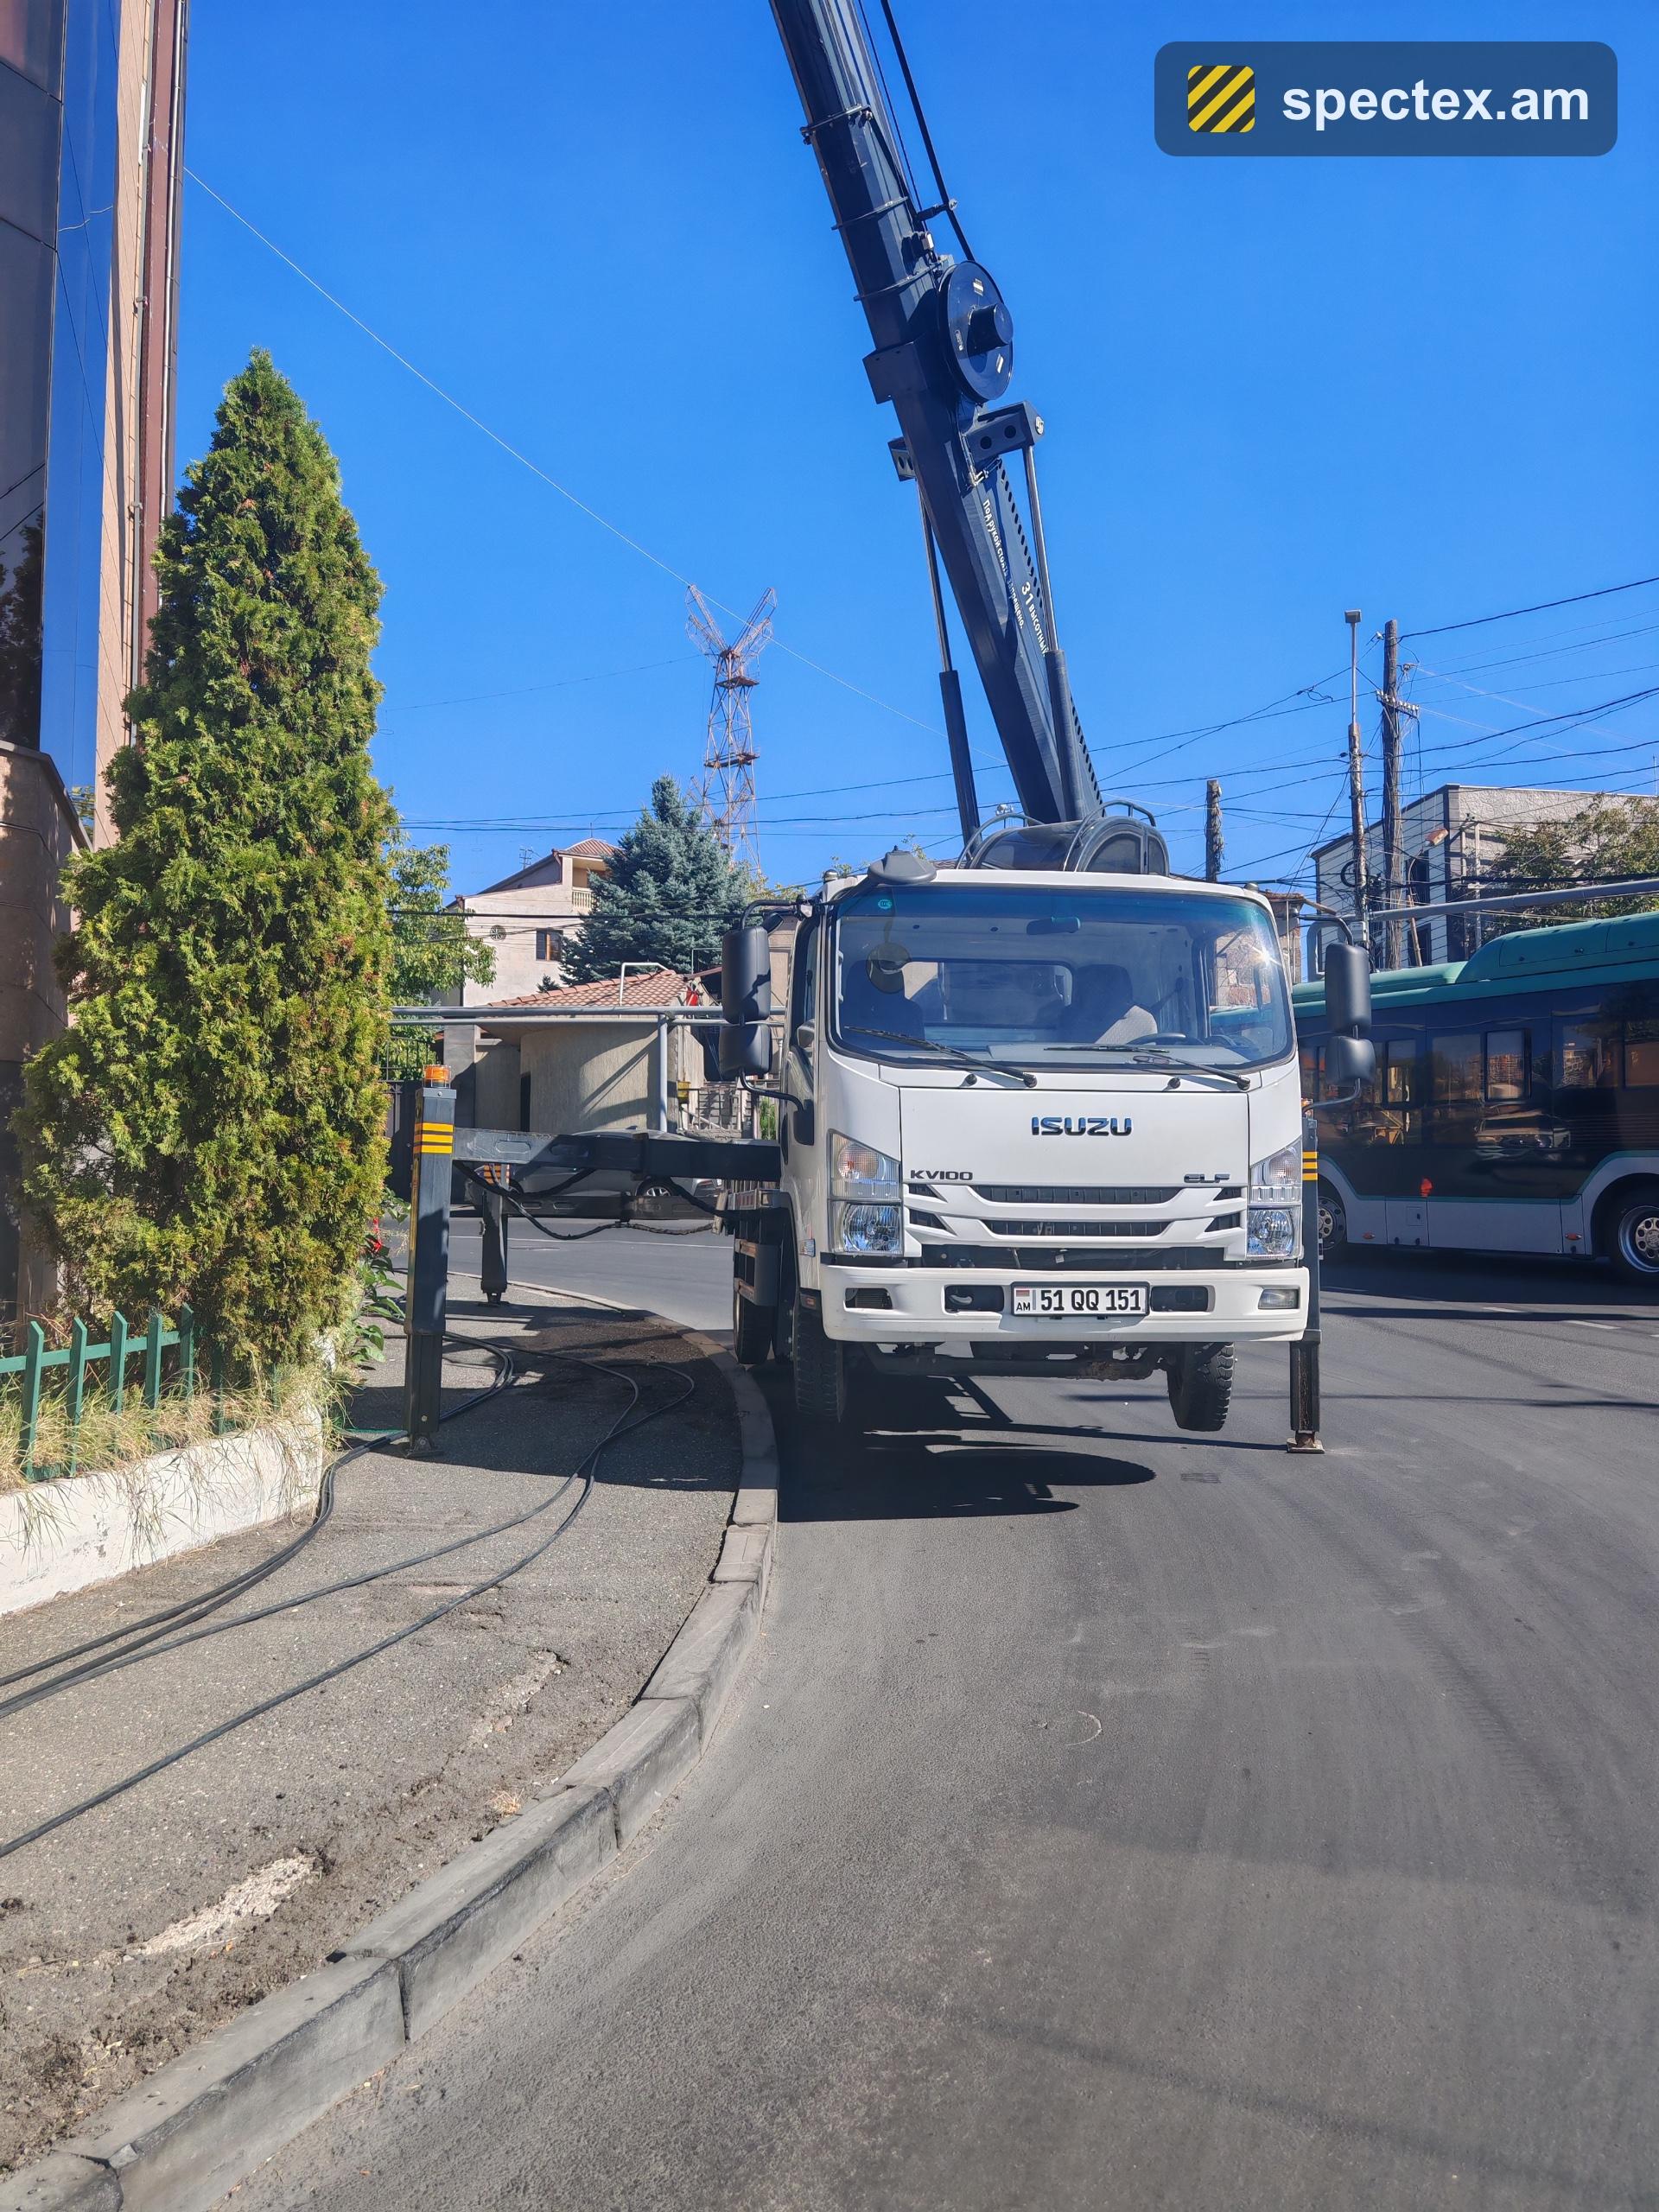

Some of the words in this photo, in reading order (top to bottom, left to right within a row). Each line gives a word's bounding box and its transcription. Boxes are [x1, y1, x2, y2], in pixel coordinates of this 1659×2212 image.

[982, 499, 993, 521] Под
[986, 521, 1001, 548] рукой
[1021, 582, 1034, 605] 31
[1031, 1116, 1133, 1136] ISUZU
[910, 1169, 974, 1181] KV100
[1183, 1173, 1231, 1184] ELF
[1015, 1302, 1031, 1312] AM
[1040, 1289, 1065, 1312] 51
[1071, 1289, 1099, 1312] QQ
[1106, 1289, 1141, 1312] 151
